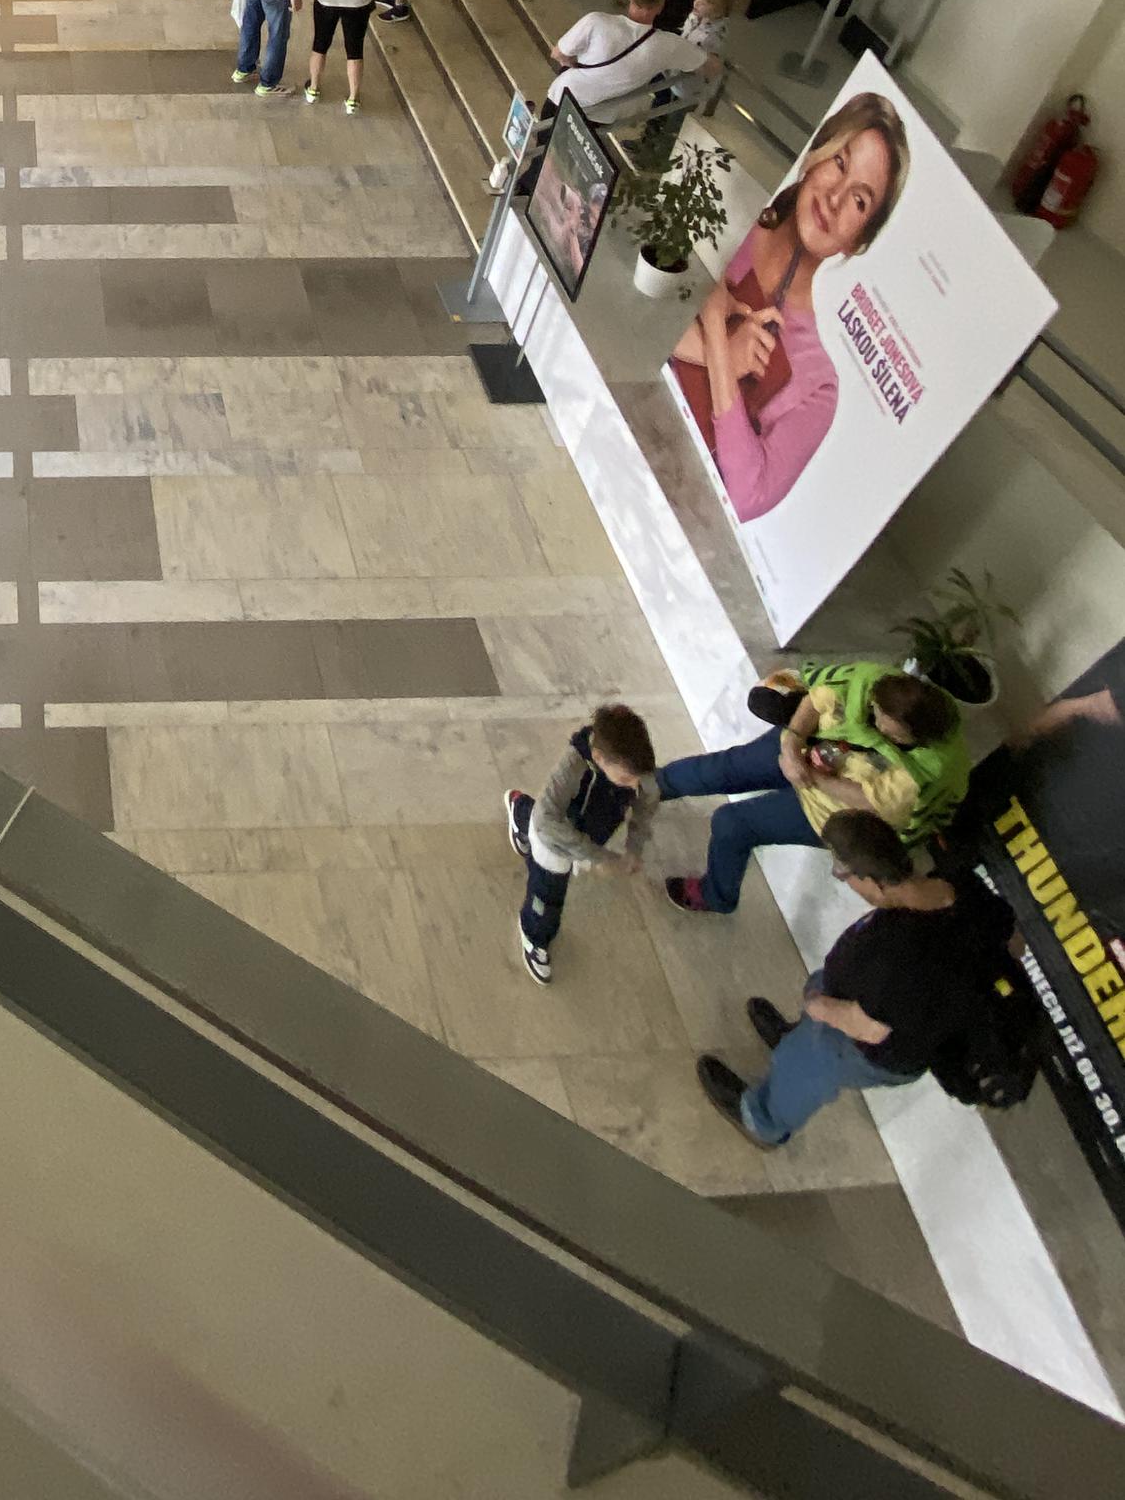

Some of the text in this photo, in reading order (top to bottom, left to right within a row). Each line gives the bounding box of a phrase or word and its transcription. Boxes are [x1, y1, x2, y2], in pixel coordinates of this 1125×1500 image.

[837, 299, 879, 366] LÁSKOU
[871, 355, 913, 425] ŠÍLENÁ
[851, 282, 887, 339] BRIDGET
[879, 334, 927, 405] JONESOVÁ
